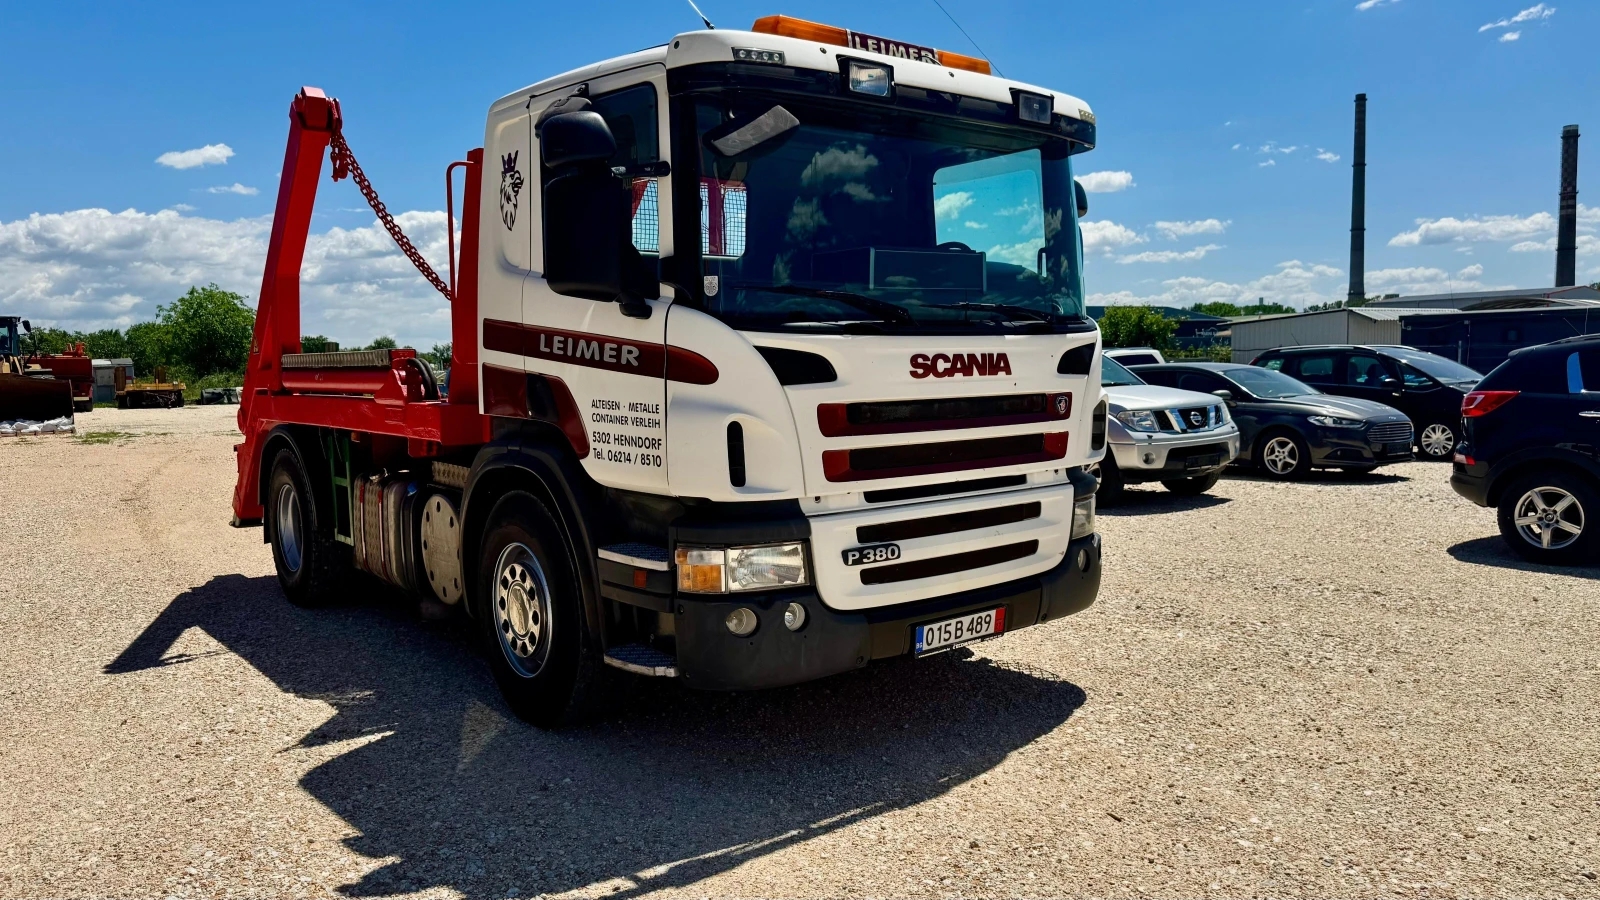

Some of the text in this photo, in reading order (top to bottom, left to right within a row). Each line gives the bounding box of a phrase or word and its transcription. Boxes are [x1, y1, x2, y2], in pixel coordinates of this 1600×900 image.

[855, 35, 935, 65] LEIMER
[540, 333, 640, 367] LEIMER
[909, 352, 1012, 379] SCANIA
[591, 398, 620, 410] ALTEISEN
[628, 402, 660, 414] METALLE
[591, 412, 661, 428] CONTAINER VERLEIH
[592, 430, 662, 450] 5302 HENNDORF
[592, 447, 605, 460] Tel.
[607, 449, 631, 464] 06214
[640, 453, 662, 467] 8510
[847, 545, 899, 566] P 380
